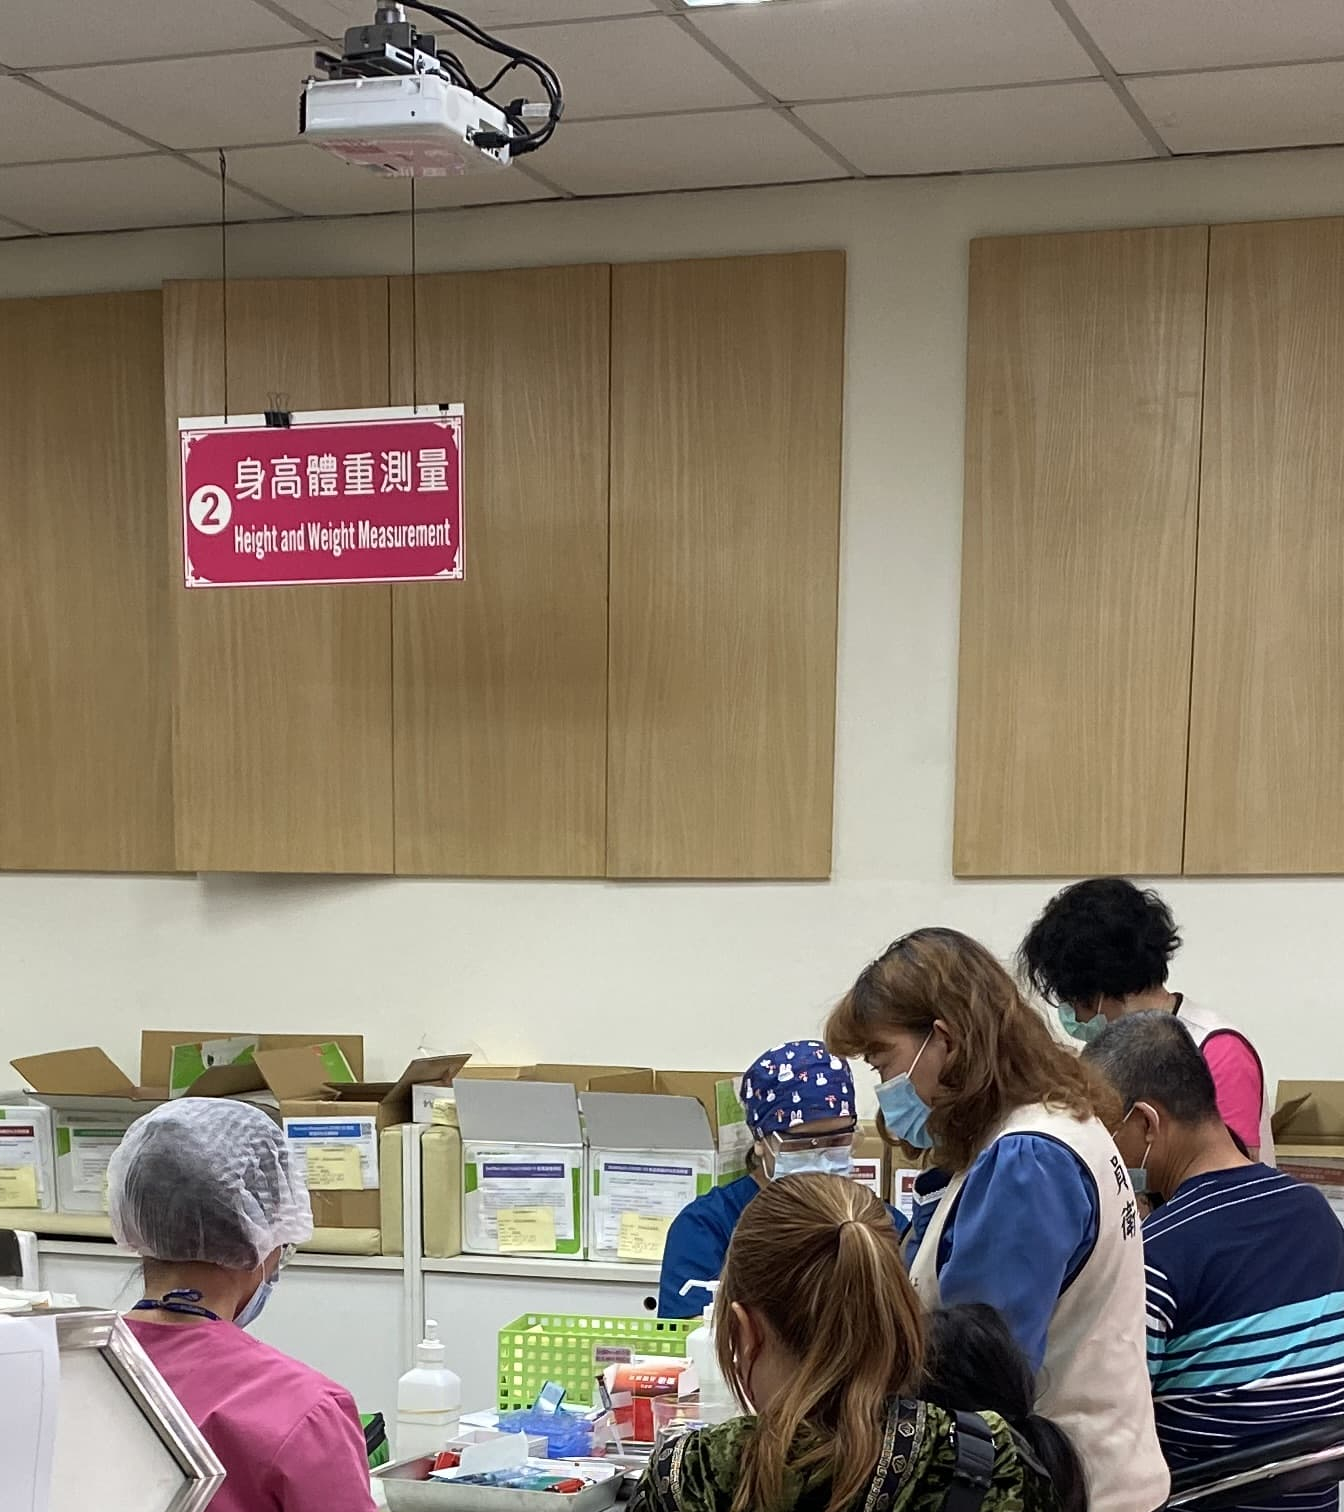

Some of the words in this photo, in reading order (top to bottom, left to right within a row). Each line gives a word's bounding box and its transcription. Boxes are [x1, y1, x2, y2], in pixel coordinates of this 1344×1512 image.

[234, 448, 449, 501] 身高體重測量
[200, 491, 221, 526] 2
[234, 524, 278, 560] Height
[281, 522, 305, 550] and
[308, 519, 356, 558] Weight
[359, 518, 451, 550] Measurement
